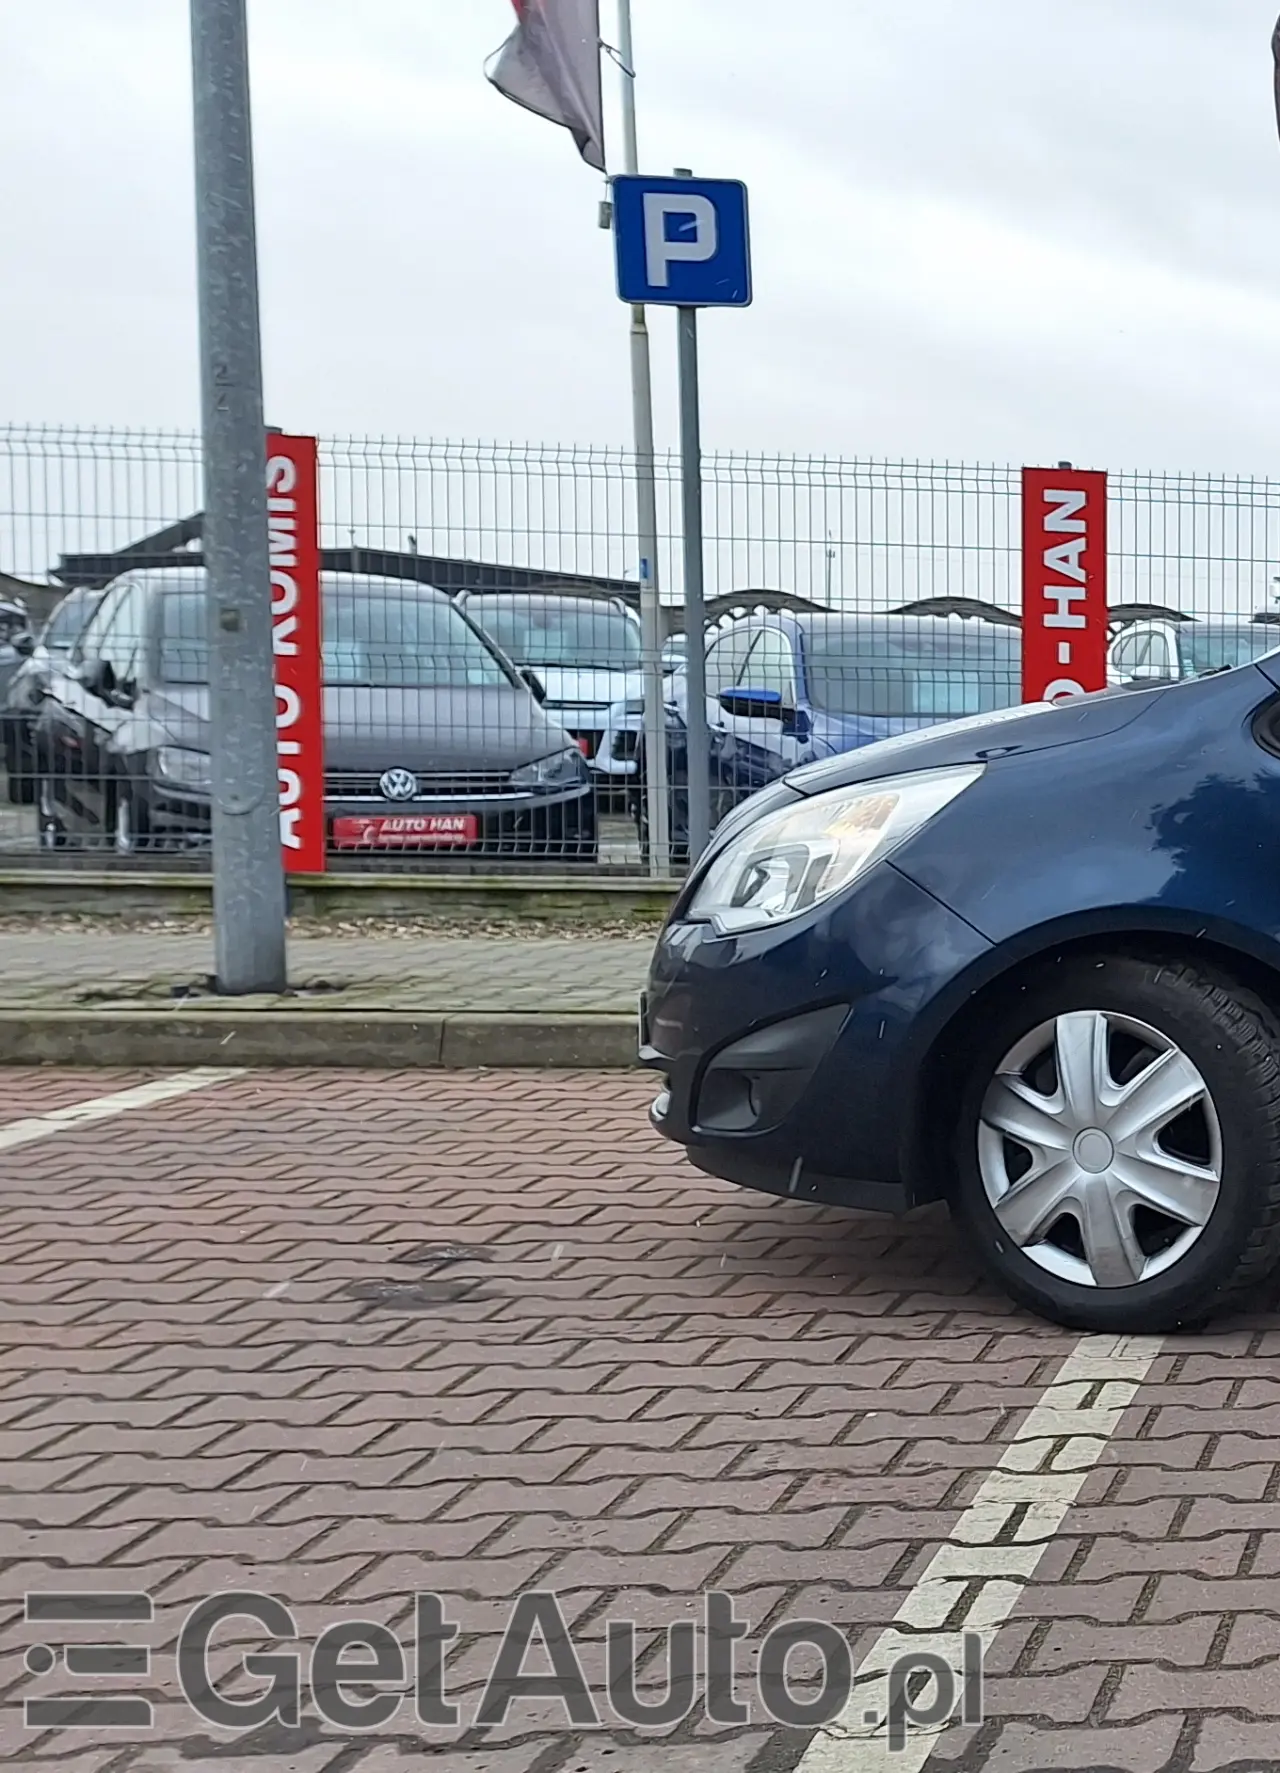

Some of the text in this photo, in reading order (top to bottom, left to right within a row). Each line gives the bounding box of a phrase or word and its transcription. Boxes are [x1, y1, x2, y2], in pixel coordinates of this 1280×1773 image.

[643, 192, 717, 287] P
[1043, 489, 1087, 629] HAN
[380, 817, 465, 832] AUTO HAN
